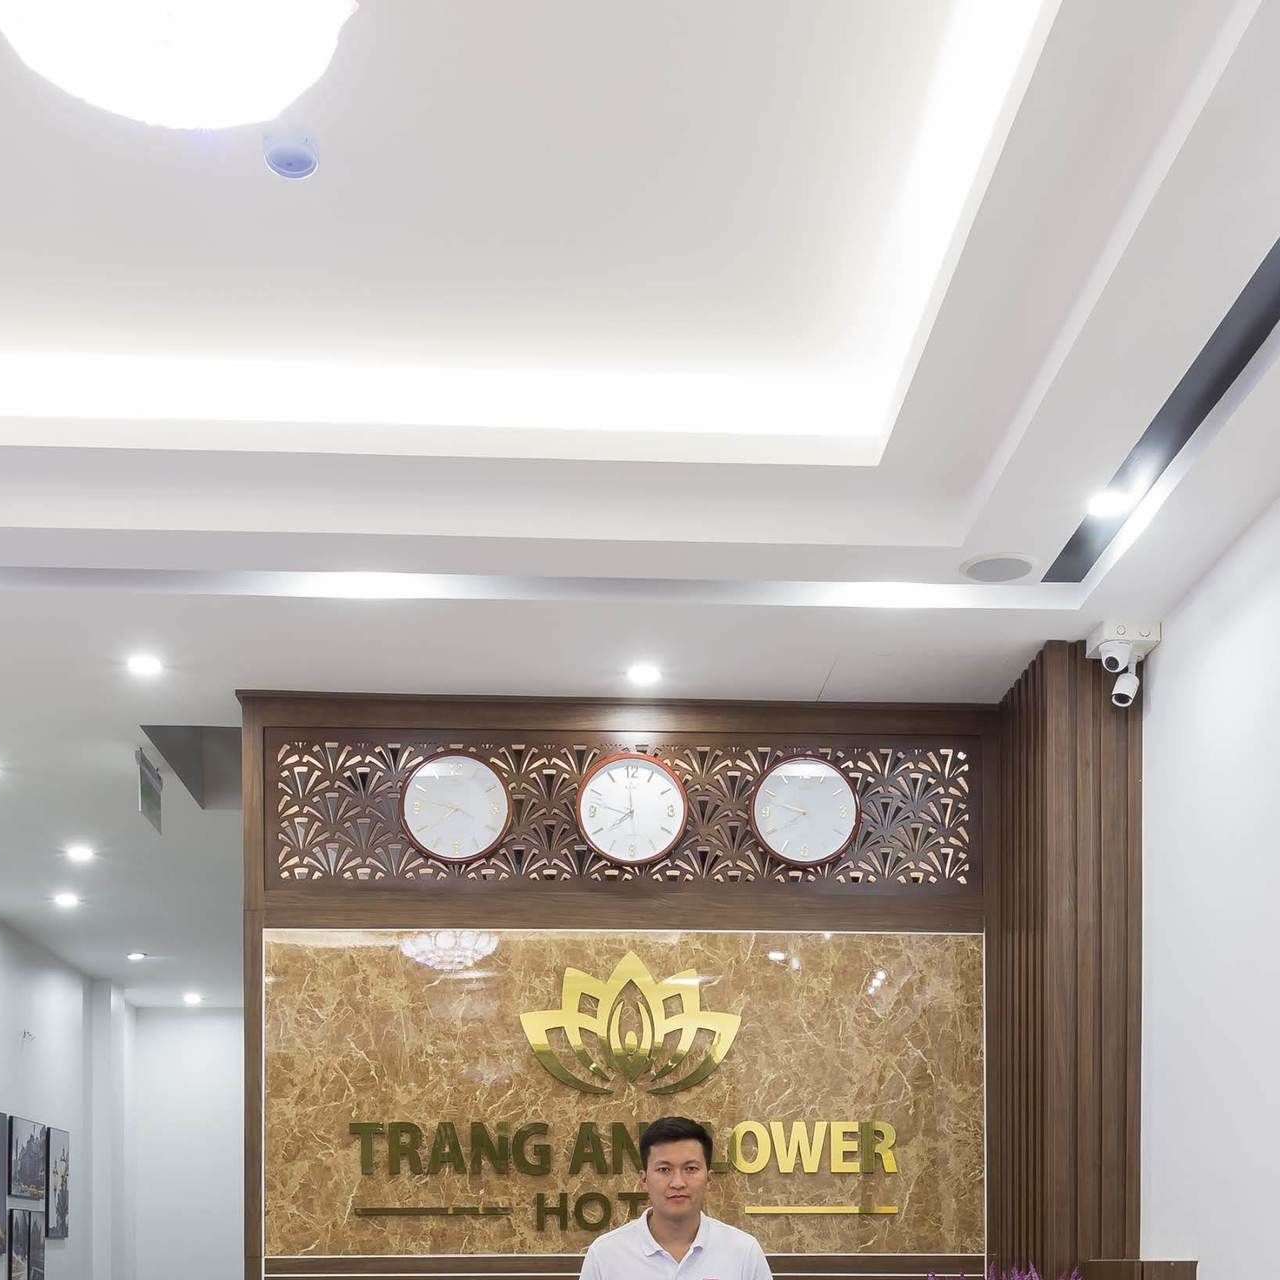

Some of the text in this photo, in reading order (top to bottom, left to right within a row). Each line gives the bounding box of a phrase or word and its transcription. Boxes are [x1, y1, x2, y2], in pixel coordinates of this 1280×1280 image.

[623, 766, 639, 778] 12
[349, 1120, 898, 1176] TRANG AN OWER
[536, 1192, 650, 1232] HOT
